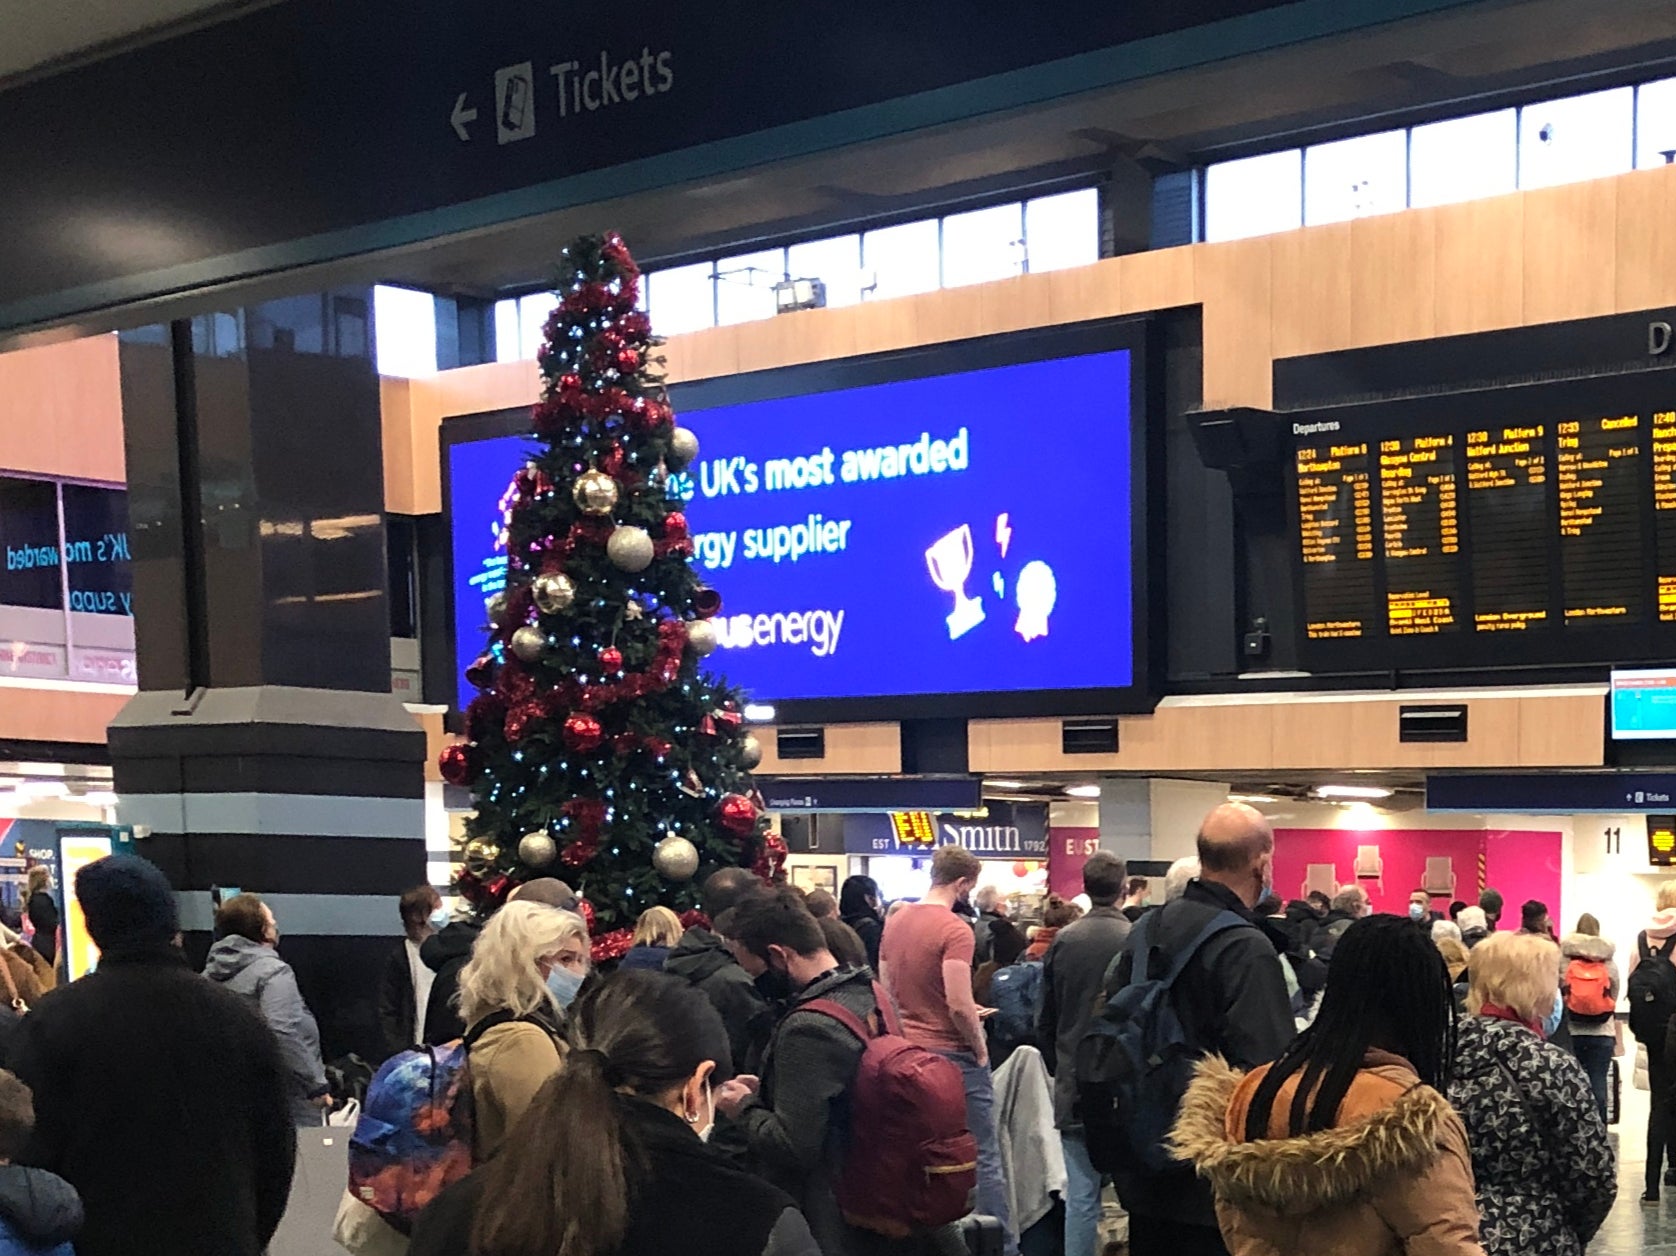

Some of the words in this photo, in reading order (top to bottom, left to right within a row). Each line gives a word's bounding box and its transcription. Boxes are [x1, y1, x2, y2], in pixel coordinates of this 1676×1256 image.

[550, 47, 673, 117] Tickets
[1293, 421, 1340, 435] Departures
[1558, 421, 1580, 434] 12:33
[1601, 415, 1639, 431] Cancelled
[1467, 443, 1497, 457] Watford
[1498, 442, 1531, 455] Junction
[1558, 436, 1580, 450] Tring
[1330, 446, 1362, 458] Platform
[1409, 450, 1437, 463] Central
[701, 457, 758, 497] UK's
[765, 447, 834, 490] most
[841, 430, 968, 482] awarded
[1297, 461, 1342, 474] Northampton
[694, 530, 737, 569] rgy
[743, 513, 851, 563] supplier
[713, 609, 844, 657] usenergy
[1646, 792, 1670, 802] Tickets
[872, 838, 889, 849] EST
[1066, 838, 1100, 855] EUST
[1604, 827, 1621, 854] 11
